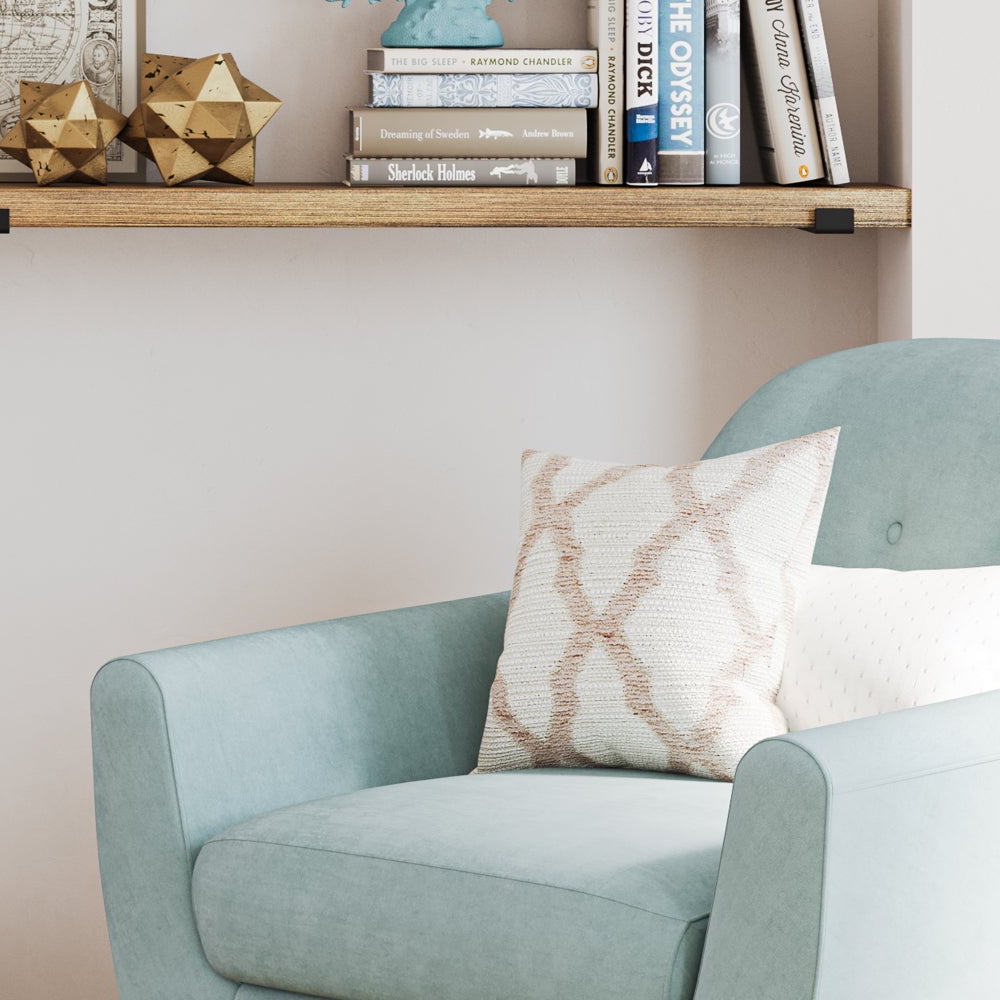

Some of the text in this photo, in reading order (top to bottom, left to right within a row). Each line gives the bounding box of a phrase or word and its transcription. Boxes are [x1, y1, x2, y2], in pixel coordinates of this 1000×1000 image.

[607, 16, 616, 43] SLEEP
[772, 19, 791, 70] Anna
[809, 24, 820, 40] END
[391, 57, 573, 66] THE BIG SLEEP RAYMOND CHANDLER
[607, 55, 616, 105] RAYMOND
[637, 42, 653, 97] DICK
[669, 40, 693, 147] ODYSSEY
[380, 128, 470, 142] Dreaming of Sweden
[522, 129, 574, 138] Andrew Brown
[607, 108, 616, 160] CHANDLER
[777, 75, 806, 158] Karenina
[825, 113, 842, 167] AUTHOR NAME
[388, 163, 476, 181] Sherlock Holmes
[556, 166, 569, 184] DOYLE
